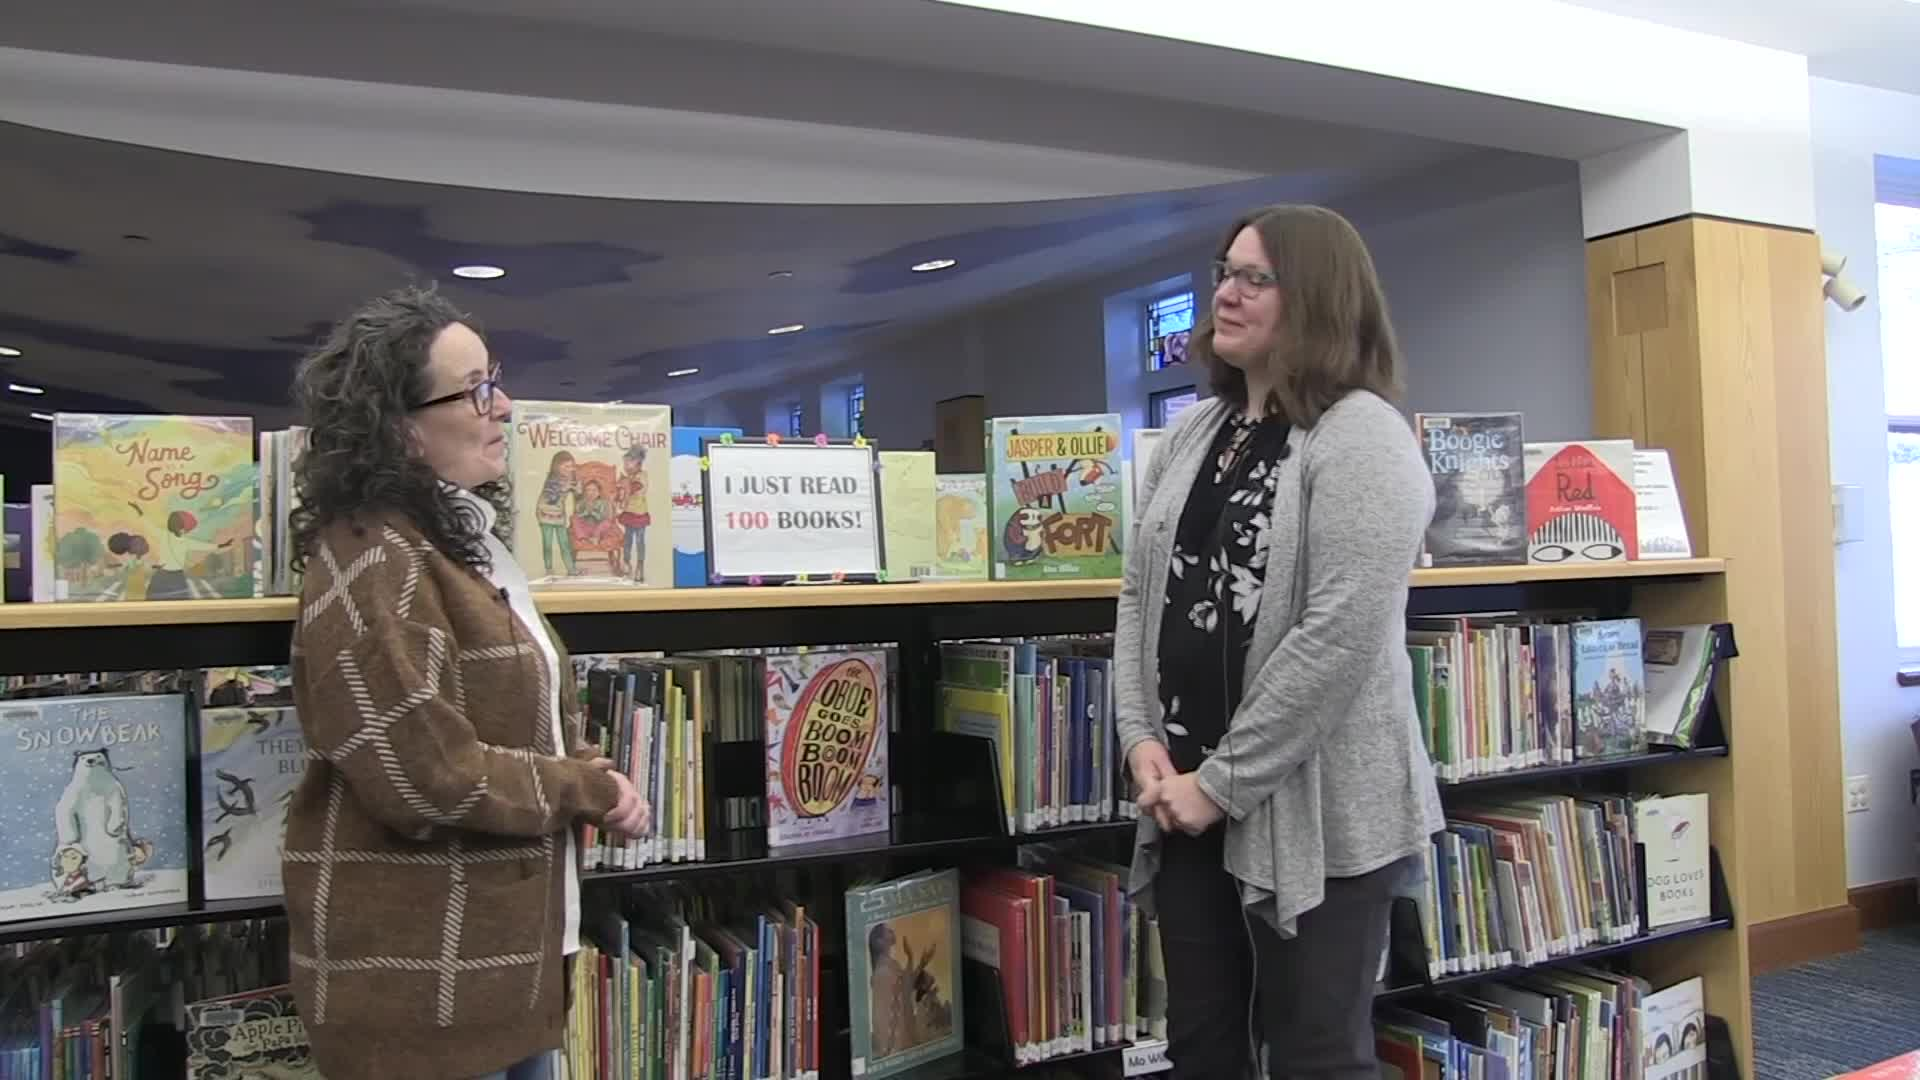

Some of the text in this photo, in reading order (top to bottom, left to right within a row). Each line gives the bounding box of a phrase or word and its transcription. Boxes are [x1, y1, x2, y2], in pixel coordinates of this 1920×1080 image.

[517, 422, 667, 450] WELCOME CHAIR
[1007, 435, 1104, 458] JASPER & OLLIE
[1429, 428, 1505, 454] Boogie
[115, 439, 196, 466] Name
[1430, 450, 1511, 475] Knights
[138, 467, 221, 501] Song
[724, 475, 857, 495] I JUST READ
[1555, 472, 1597, 502] Red
[726, 510, 863, 530] 100 BOOKS!
[1042, 512, 1112, 553] FORT
[820, 679, 872, 718] OBOE
[70, 706, 114, 721] THE
[817, 708, 861, 729] GOES
[16, 721, 162, 752] SNOWBEAR
[804, 719, 868, 750] BOOM
[801, 742, 864, 771] BOOM
[799, 763, 853, 805] BOOM
[1648, 867, 1705, 888] DOG LOVES
[1660, 887, 1695, 902] BOOKS
[232, 1017, 303, 1044] Apple Pi
[1129, 1056, 1145, 1067] Mo
